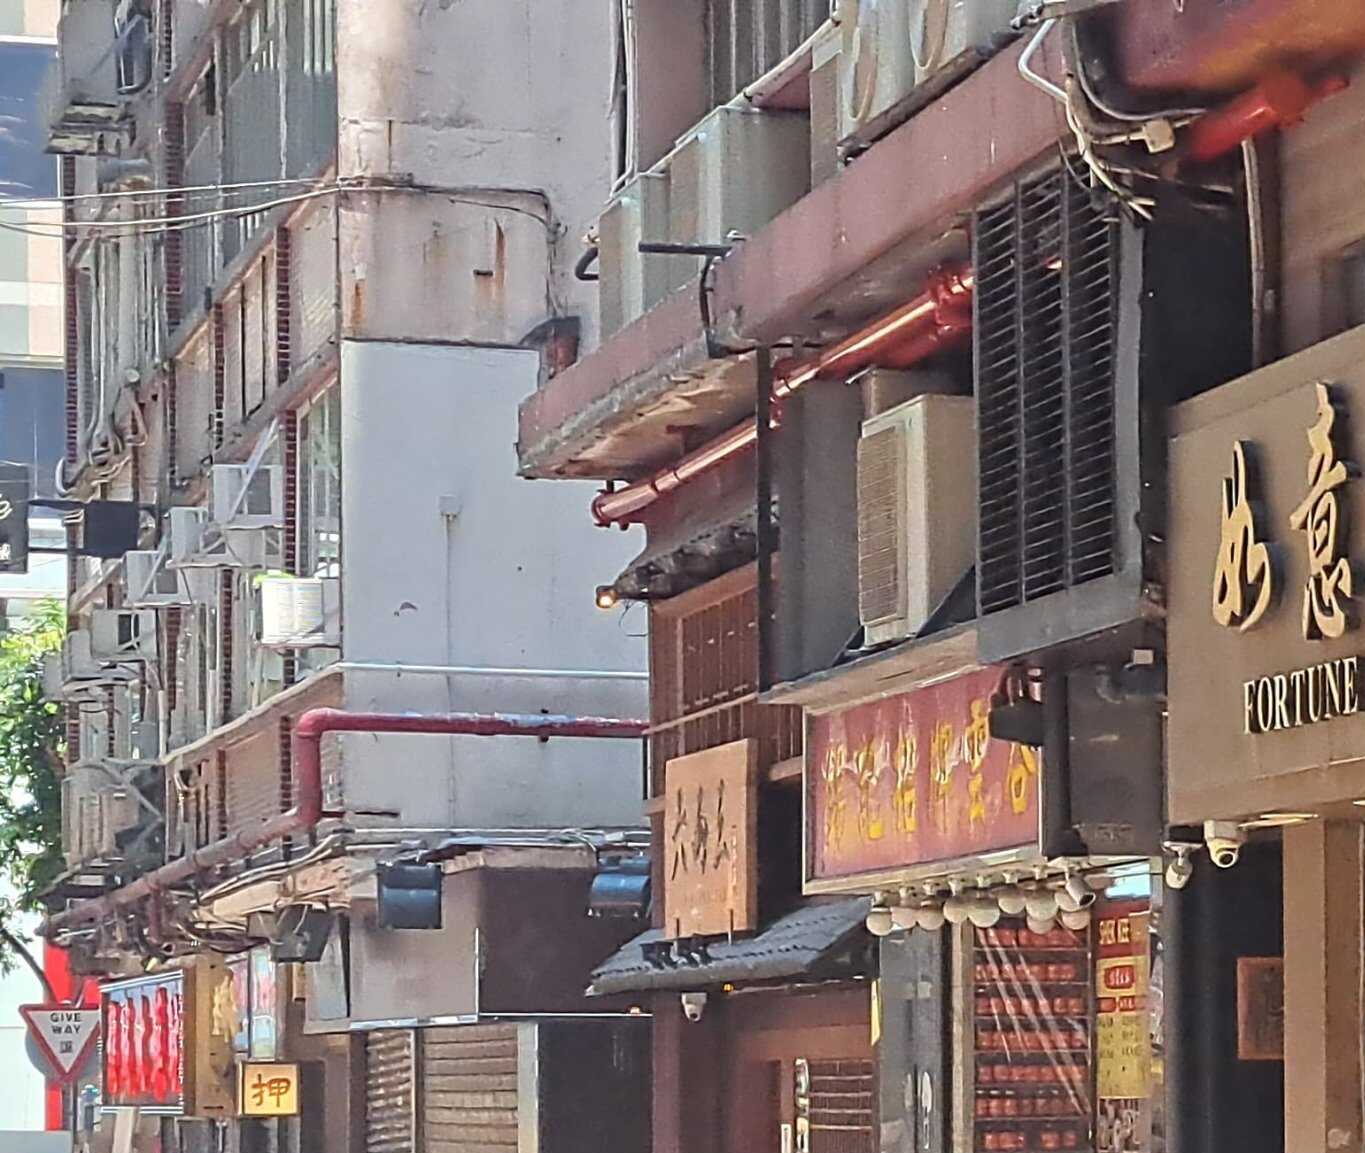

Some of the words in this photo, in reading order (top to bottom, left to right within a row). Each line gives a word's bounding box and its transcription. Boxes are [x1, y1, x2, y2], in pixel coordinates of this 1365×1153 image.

[1243, 656, 1358, 735] FORTUNE
[50, 1012, 81, 1023] GIVE
[51, 1024, 81, 1034] WAY
[251, 1074, 291, 1107] 押
